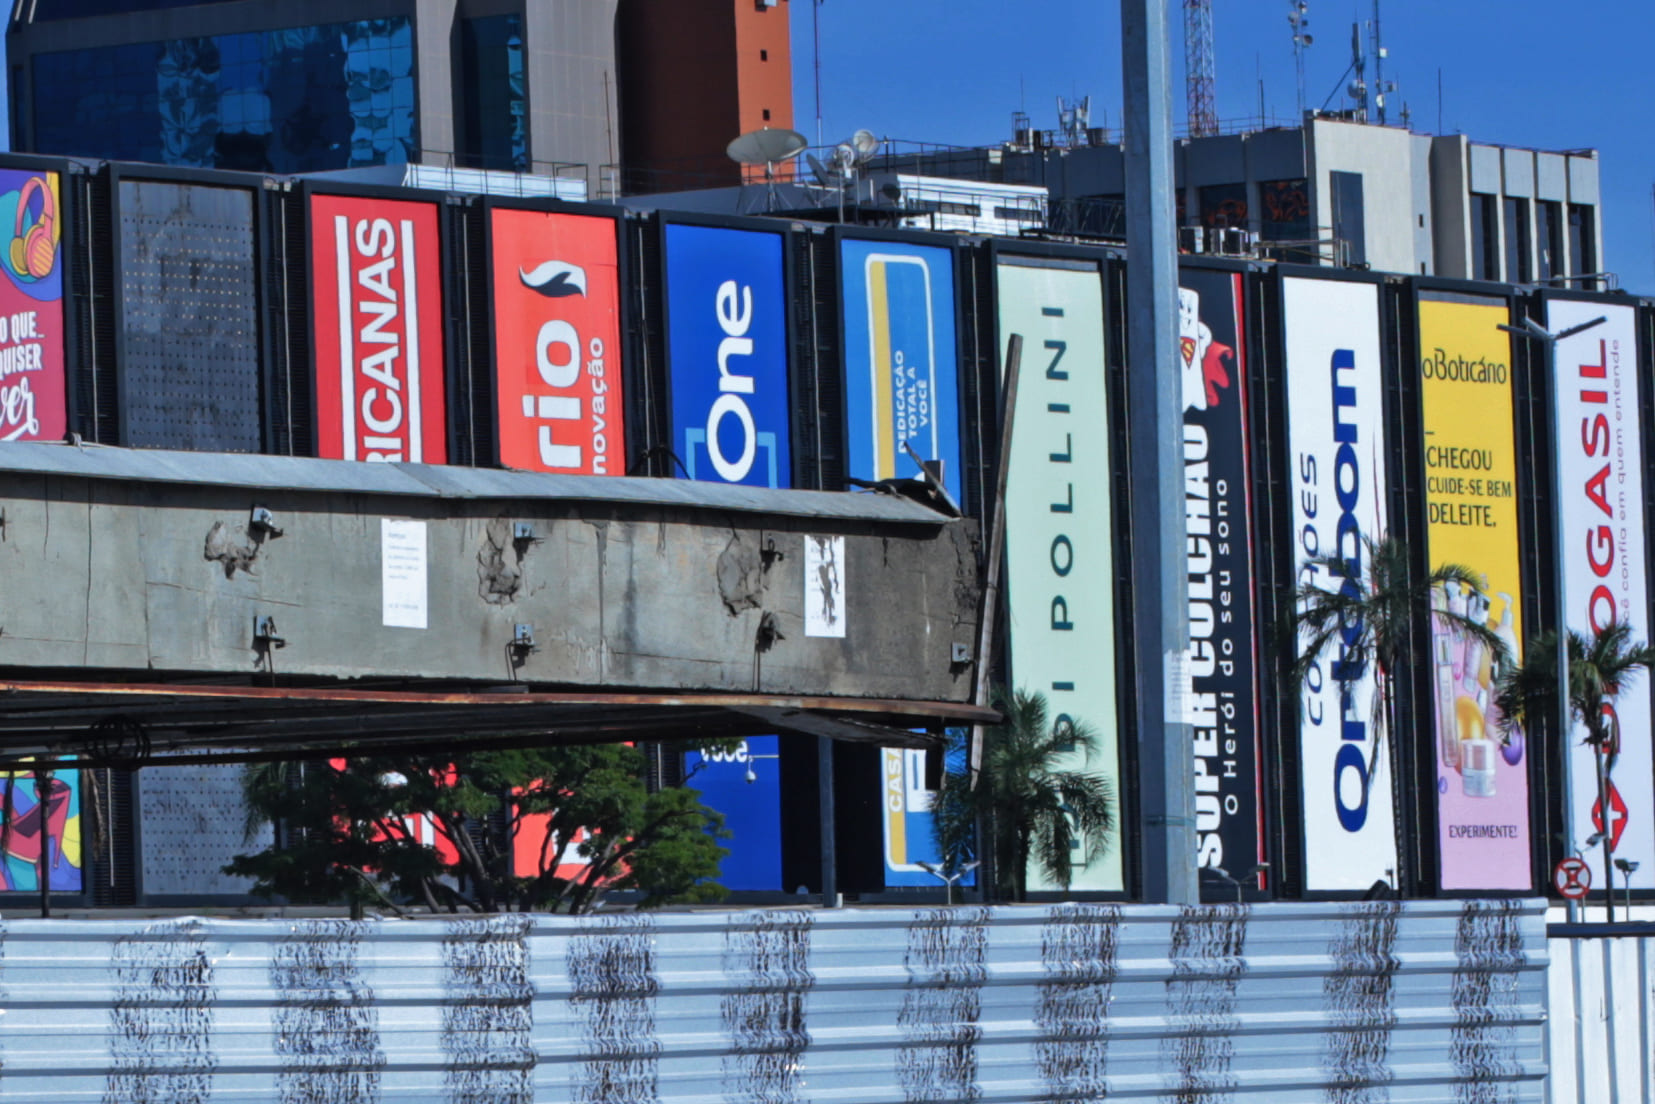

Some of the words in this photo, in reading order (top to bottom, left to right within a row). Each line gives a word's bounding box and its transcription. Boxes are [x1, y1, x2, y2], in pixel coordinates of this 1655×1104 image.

[11, 311, 37, 344] QUE
[355, 218, 404, 463] ICANAS
[522, 319, 582, 468] rio
[706, 279, 757, 483] One
[907, 367, 916, 379] A
[907, 384, 918, 438] TOTAL
[917, 379, 929, 427] VOCÊ
[1041, 306, 1073, 632] POLLINI
[1426, 445, 1492, 471] CHEGOU
[1428, 476, 1483, 496] CUIDE-SE
[1486, 480, 1512, 498] BEM
[1619, 491, 1627, 520] em
[1216, 479, 1229, 554] sono
[1429, 502, 1496, 528] DELEITE.
[1220, 571, 1231, 623] seu
[1219, 638, 1233, 676] do
[1220, 692, 1236, 777] Herói
[1225, 795, 1238, 815] O
[1448, 824, 1518, 839] EXPERIMENTE!
